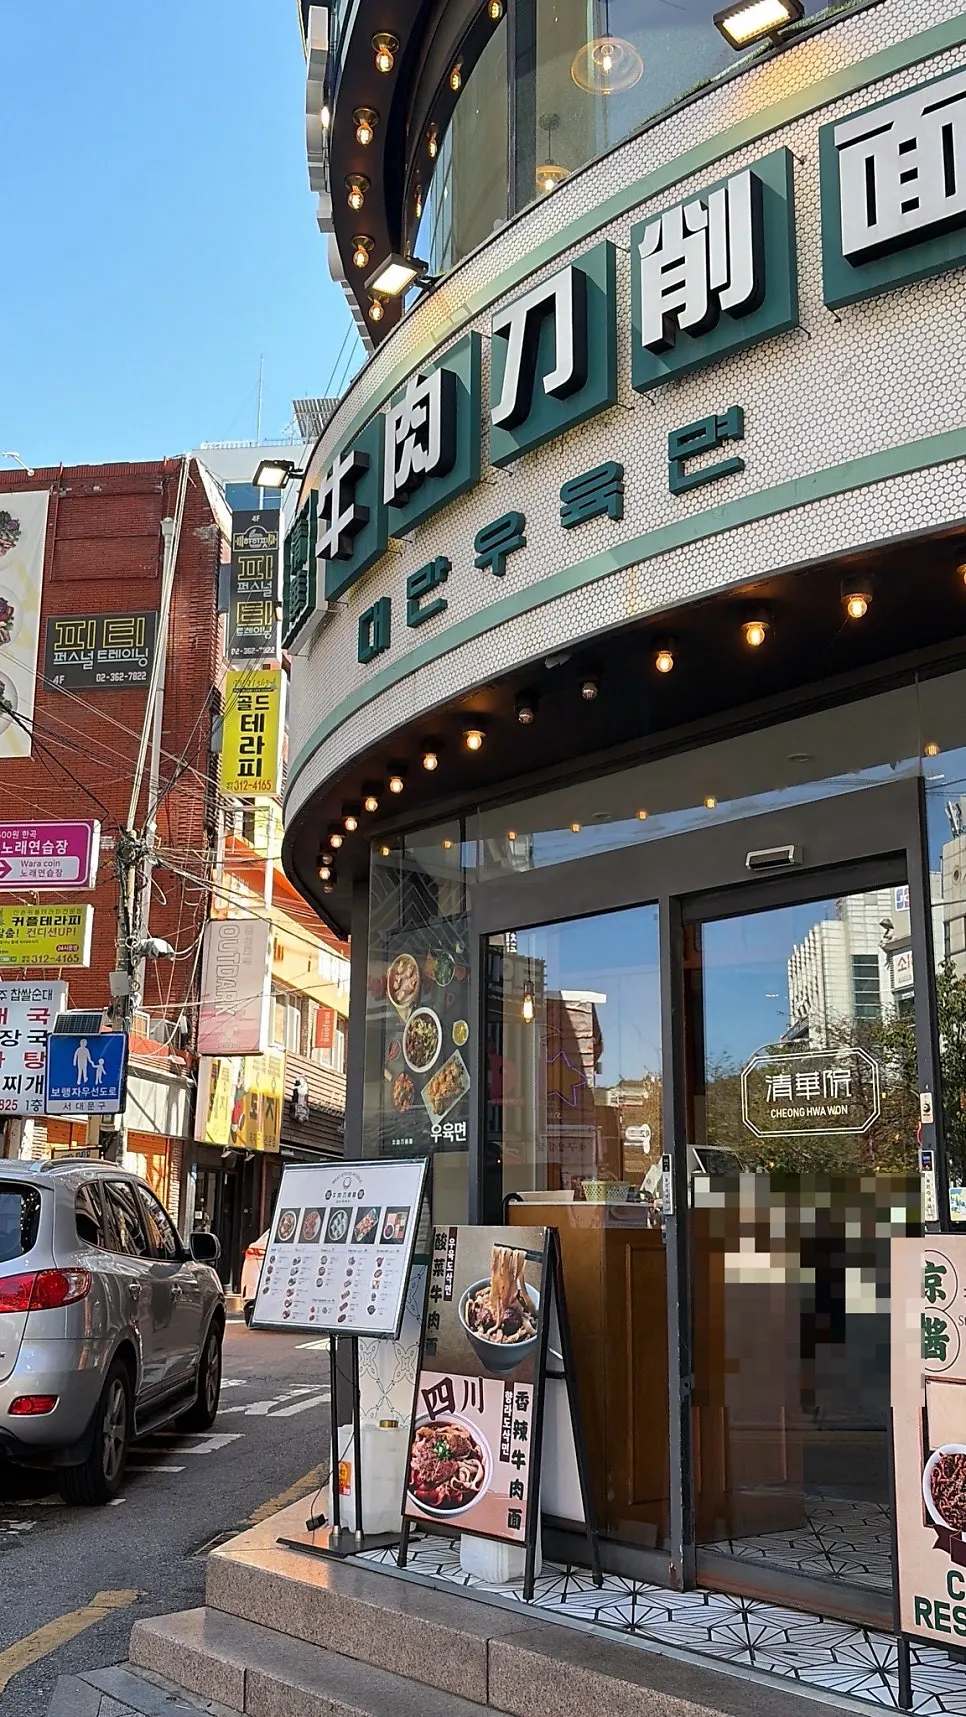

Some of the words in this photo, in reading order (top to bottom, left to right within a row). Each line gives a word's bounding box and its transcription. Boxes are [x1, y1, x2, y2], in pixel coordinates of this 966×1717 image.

[358, 405, 744, 663] 대만우육면
[237, 581, 272, 597] 퍼스널
[54, 617, 146, 651] 피티
[236, 626, 272, 640] 트레이닝
[53, 650, 94, 670] 퍼스널
[97, 647, 149, 667] 트레이닝
[52, 674, 65, 685] 4F
[95, 671, 147, 682] 02-362-7822
[237, 695, 270, 711] 골드
[237, 713, 266, 777] 테라피
[233, 780, 272, 791] 312-4165
[22, 829, 37, 839] 한곡
[0, 839, 69, 855] 노래연습장
[20, 860, 41, 868] Wara
[43, 859, 61, 868] coin
[20, 868, 63, 878] 노래연습장
[12, 915, 81, 926] 커플테라피
[27, 927, 76, 938] 컨디션UP!
[31, 954, 80, 963] 312-4165
[215, 924, 240, 1016] OUTDARK
[10, 988, 53, 1001] 찹쌀순대
[50, 1086, 118, 1097] 보행자우선도로
[765, 1069, 853, 1102] 清華院
[25, 1099, 43, 1112] 1층
[770, 1107, 805, 1118] CHEONG
[806, 1105, 826, 1117] HWA
[826, 1104, 849, 1116] WON
[430, 1121, 467, 1144] 우육면
[421, 1377, 485, 1421] 四川
[507, 1391, 530, 1531] 香辣牛肉面
